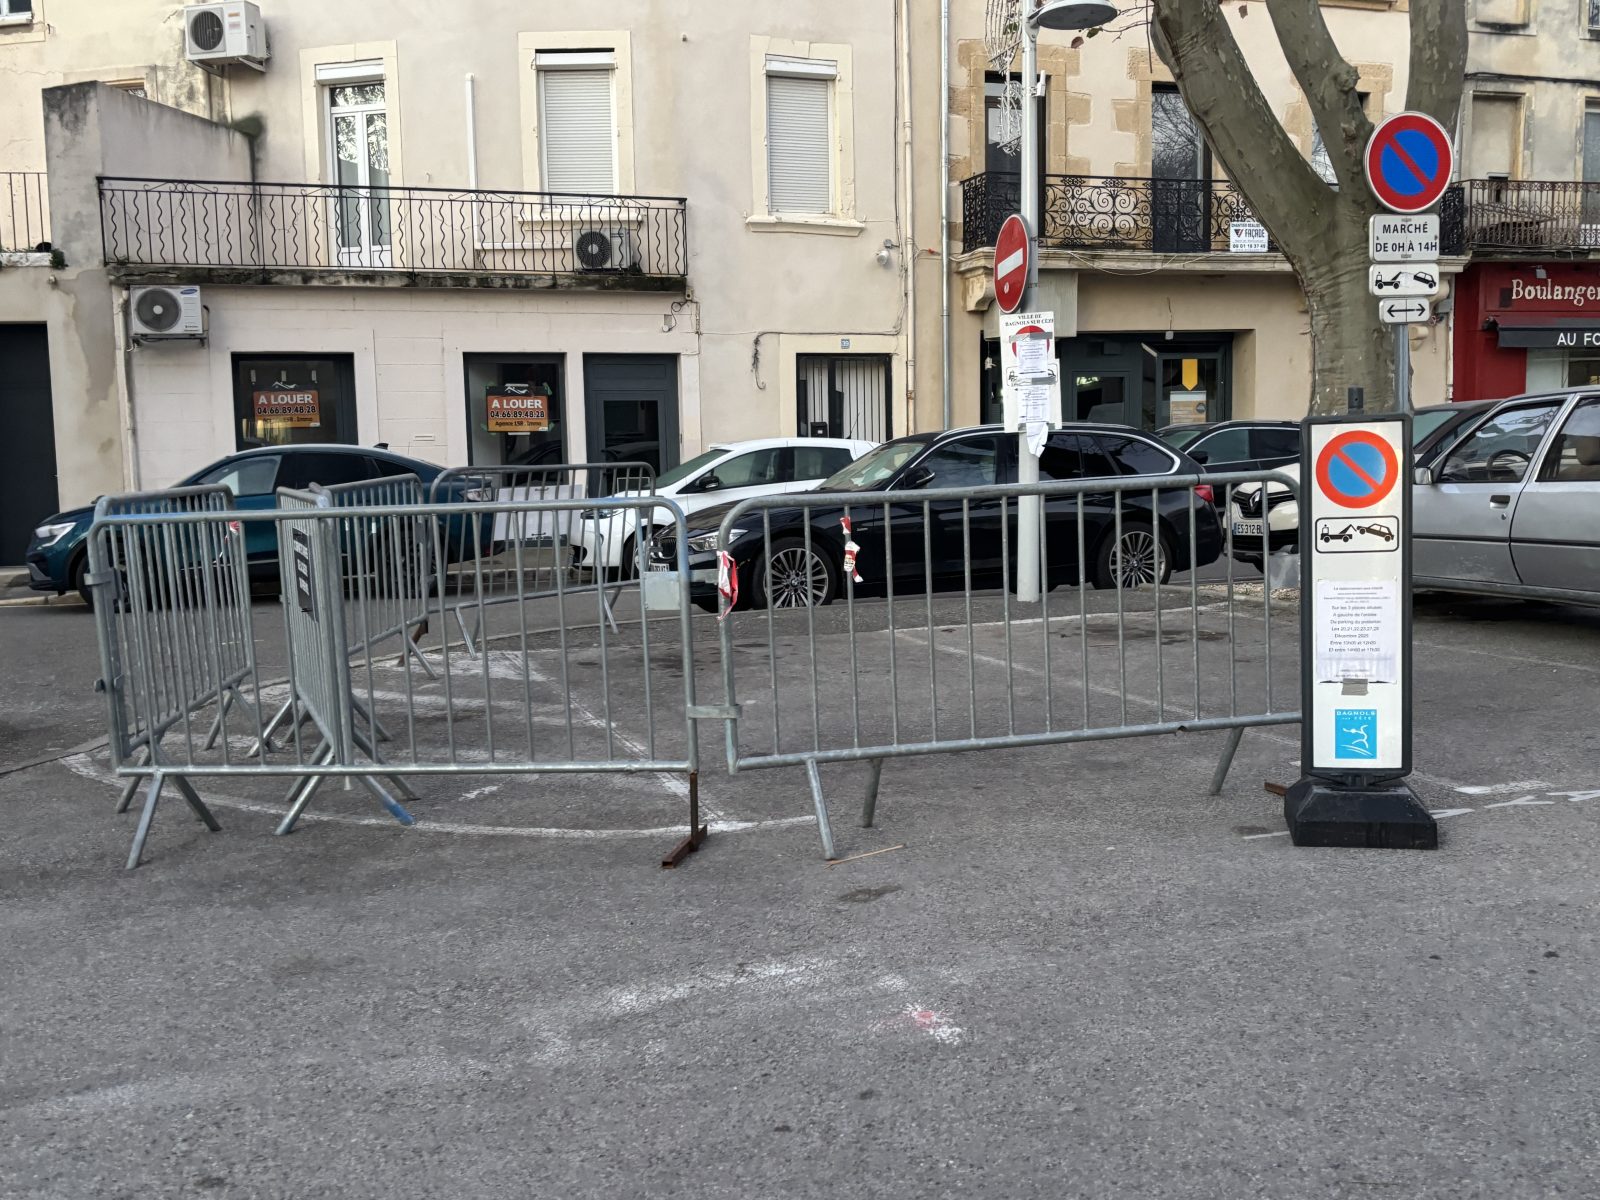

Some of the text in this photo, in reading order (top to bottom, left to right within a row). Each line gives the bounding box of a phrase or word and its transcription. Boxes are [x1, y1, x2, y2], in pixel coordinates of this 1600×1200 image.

[1244, 228, 1265, 239] FAÇADE
[1382, 222, 1428, 234] MARCHÉ
[1376, 240, 1437, 252] DE 0H À 14H
[1556, 332, 1576, 346] AU
[259, 394, 314, 405] A LOUER
[492, 399, 543, 408] A LOUER
[257, 406, 316, 414] 04.66.89.48.28
